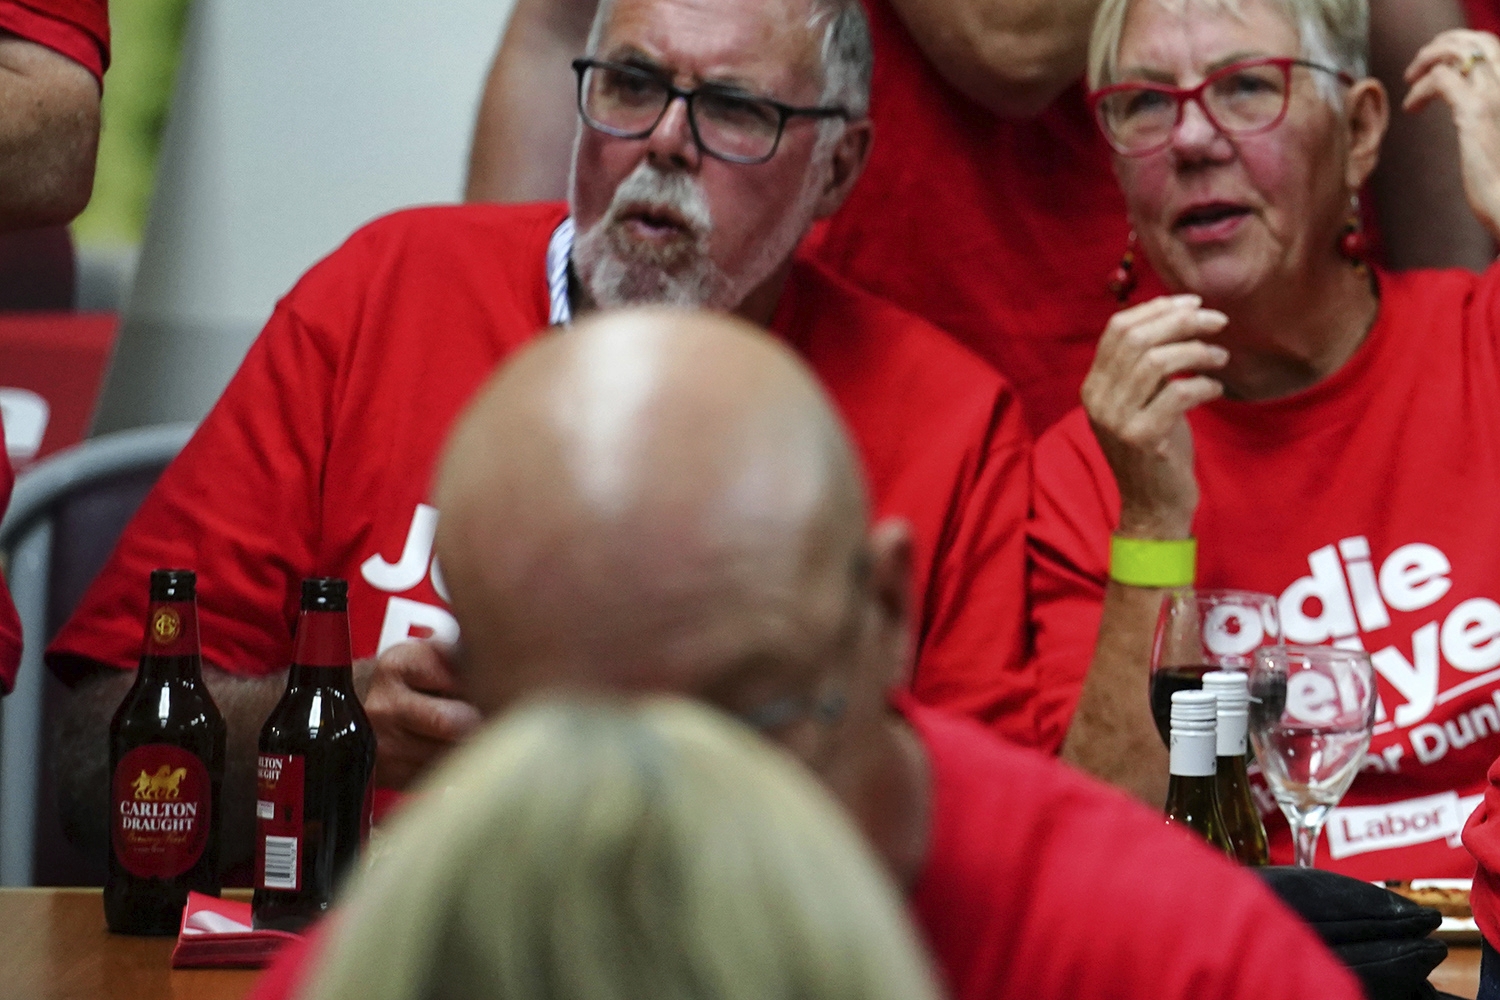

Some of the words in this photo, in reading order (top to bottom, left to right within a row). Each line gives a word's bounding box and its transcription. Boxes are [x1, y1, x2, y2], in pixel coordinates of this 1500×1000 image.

[120, 800, 198, 818] CARLTON
[122, 816, 195, 832] DRAUGHT
[1340, 806, 1446, 844] Labor
